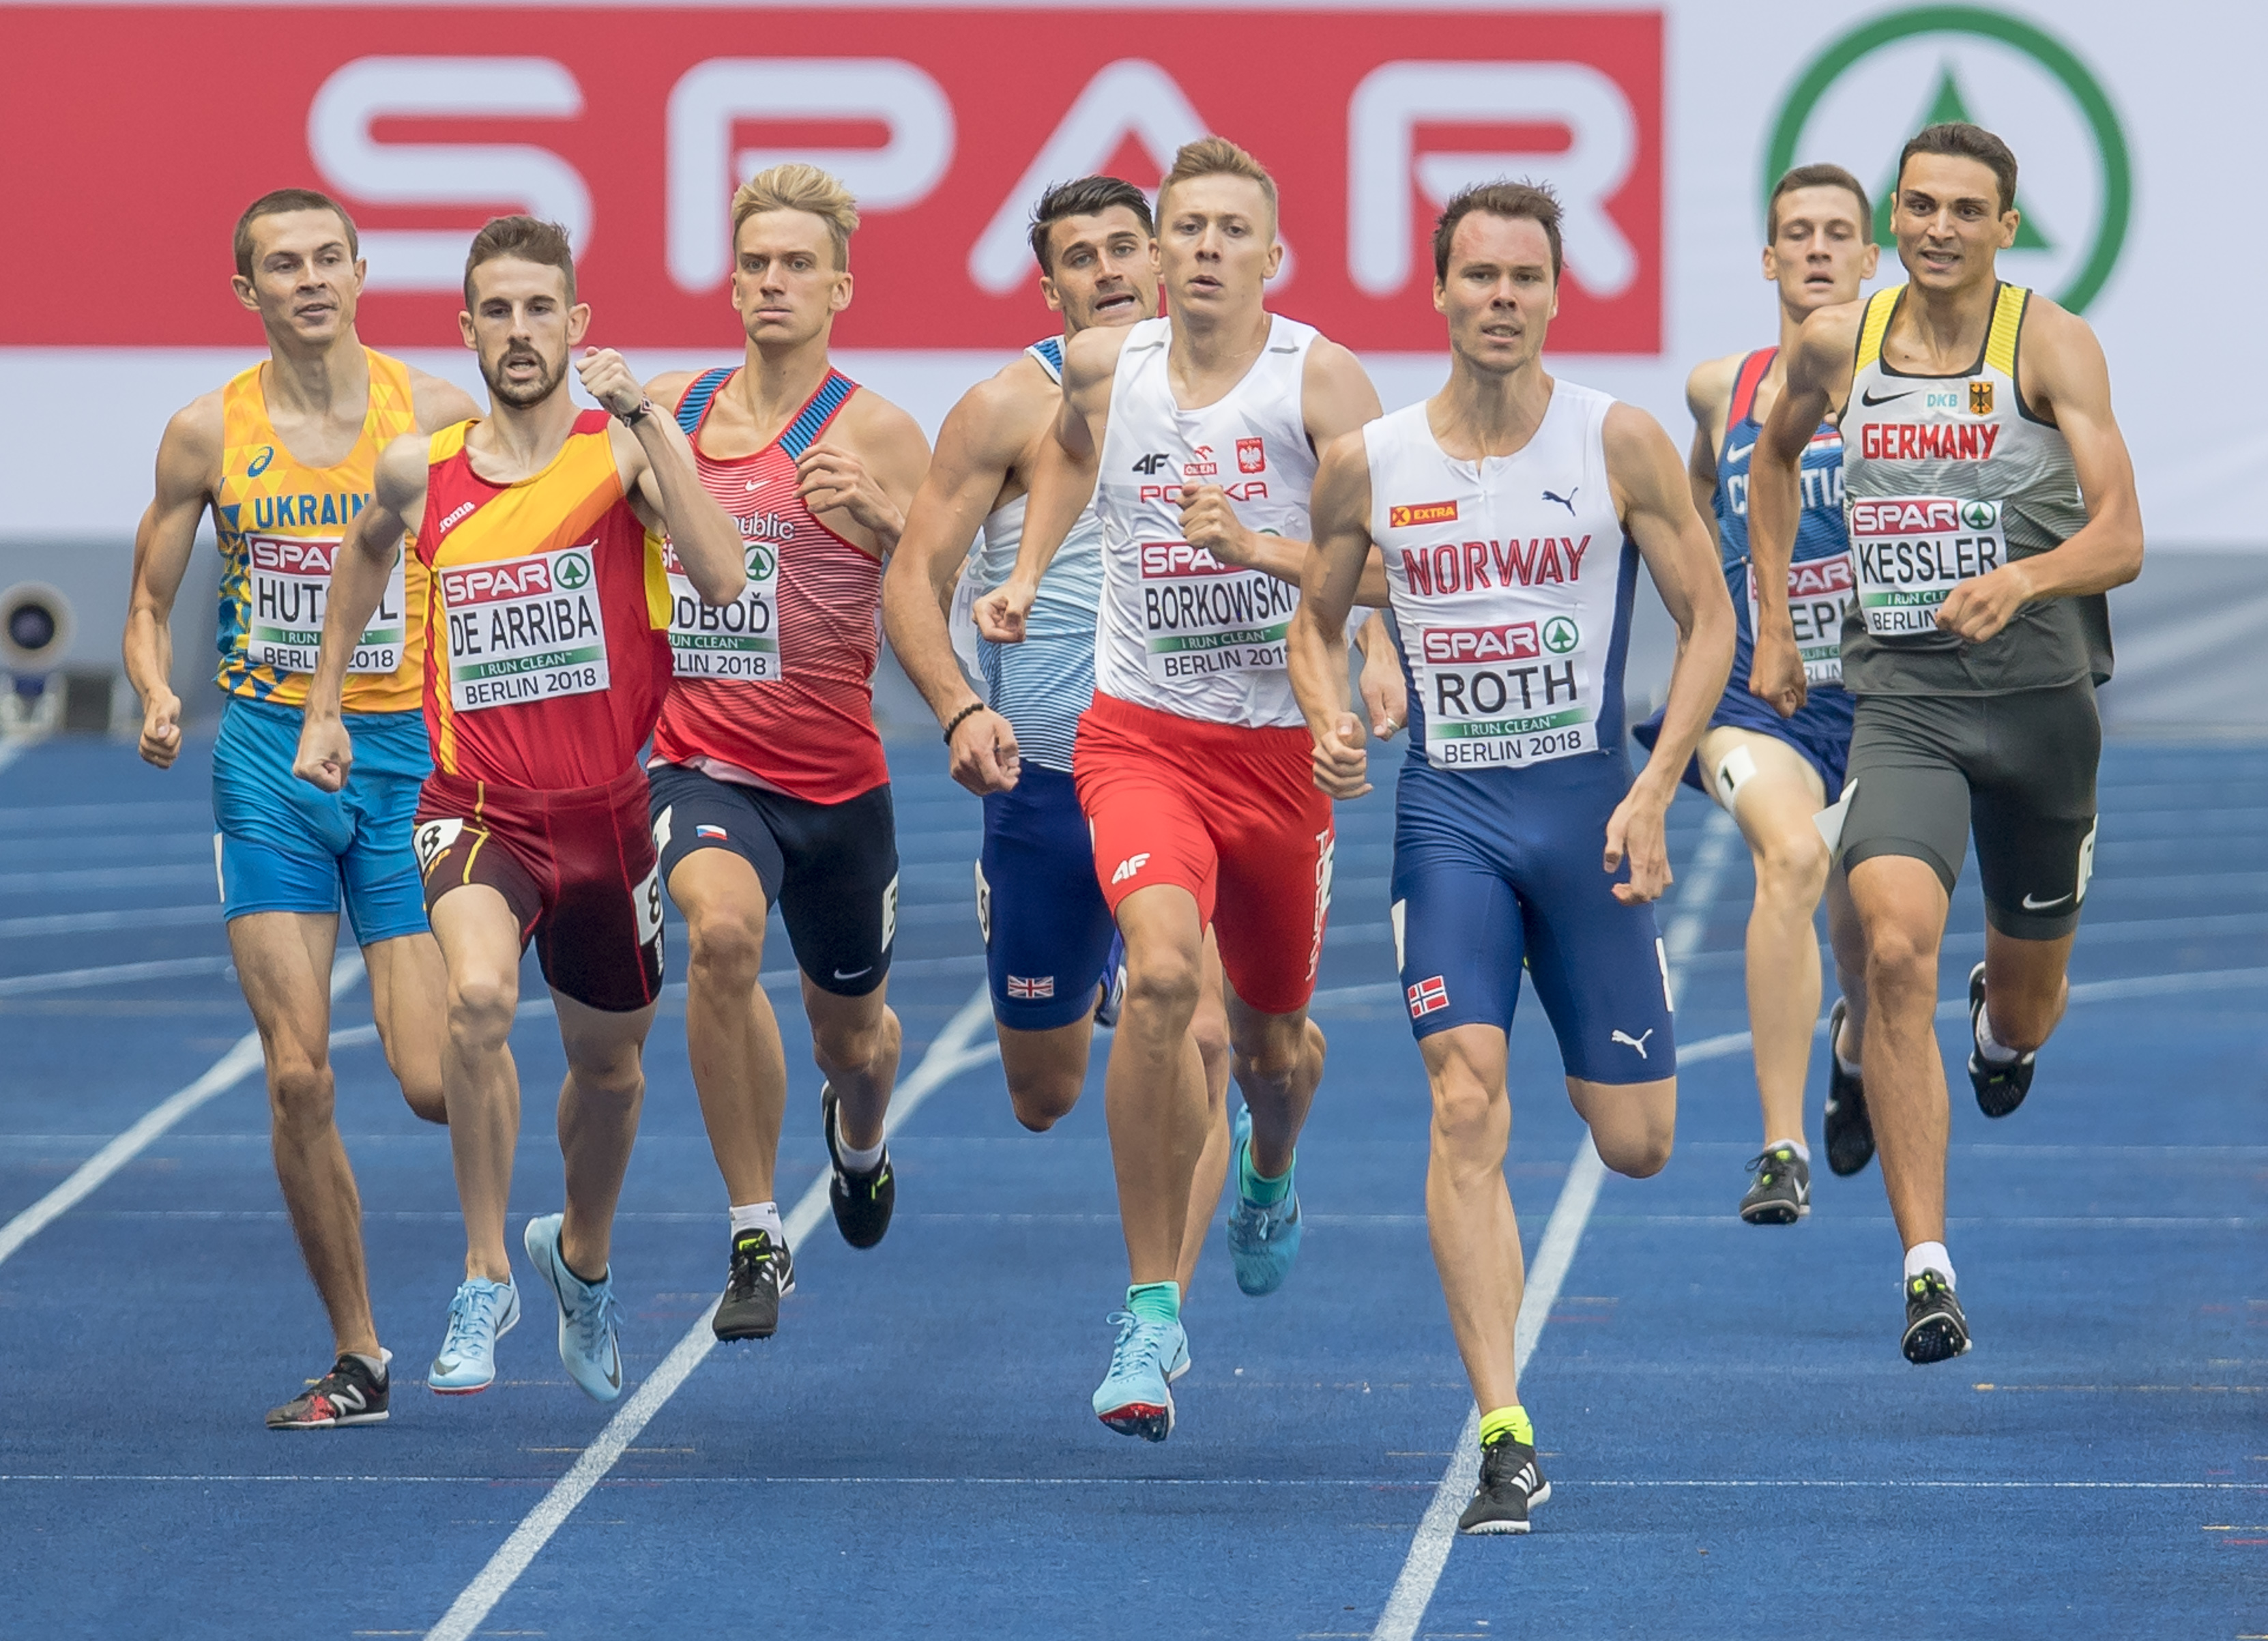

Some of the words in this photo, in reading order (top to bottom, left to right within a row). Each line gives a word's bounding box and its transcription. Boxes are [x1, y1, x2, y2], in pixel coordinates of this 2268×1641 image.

[307, 55, 1638, 297] SPAR
[1927, 394, 1958, 407] DKB
[1861, 423, 2000, 460] GERMANY
[1132, 453, 1169, 475] 4F
[1139, 481, 1268, 504] POKA
[255, 493, 370, 529] UKRAIN
[732, 512, 795, 540] ublic
[1414, 506, 1455, 519] EXTRA
[1855, 503, 1956, 531] SPAR
[1143, 546, 1225, 573] SPA
[1401, 535, 1591, 596] NORWAY
[1858, 536, 1998, 583] KESSLER
[446, 563, 549, 602] SPAR
[1887, 594, 1891, 605] I
[1894, 592, 1919, 605] RUN
[1923, 591, 1947, 603] CLE
[259, 577, 398, 623] HUTL
[670, 592, 770, 634] DBOĎ
[1144, 575, 1292, 630] BORKOWSKI
[450, 611, 482, 657] DE
[490, 595, 598, 652] ARRIBA
[1872, 609, 1938, 630] BERLIN
[282, 631, 286, 642] I
[288, 631, 317, 643] RUN
[1181, 638, 1185, 649] I
[1188, 635, 1217, 648] RUN
[1425, 627, 1539, 659] SPAR
[263, 647, 319, 669] BERLI
[480, 664, 485, 676] I
[488, 660, 517, 675] RUN
[716, 656, 766, 675] 2018
[1164, 649, 1242, 677] BERLIN
[1247, 647, 1289, 666] 201
[465, 676, 539, 705] BERLIN
[545, 667, 596, 692] 2018
[1435, 659, 1578, 716] ROTH
[1463, 725, 1467, 736] I
[1470, 723, 1500, 736] RUN
[1444, 740, 1522, 764] BERLIN
[1529, 731, 1581, 756] 2018
[1720, 765, 1734, 792] 1
[421, 825, 441, 865] 8
[1111, 852, 1150, 885] 4F
[648, 876, 661, 925] 8
